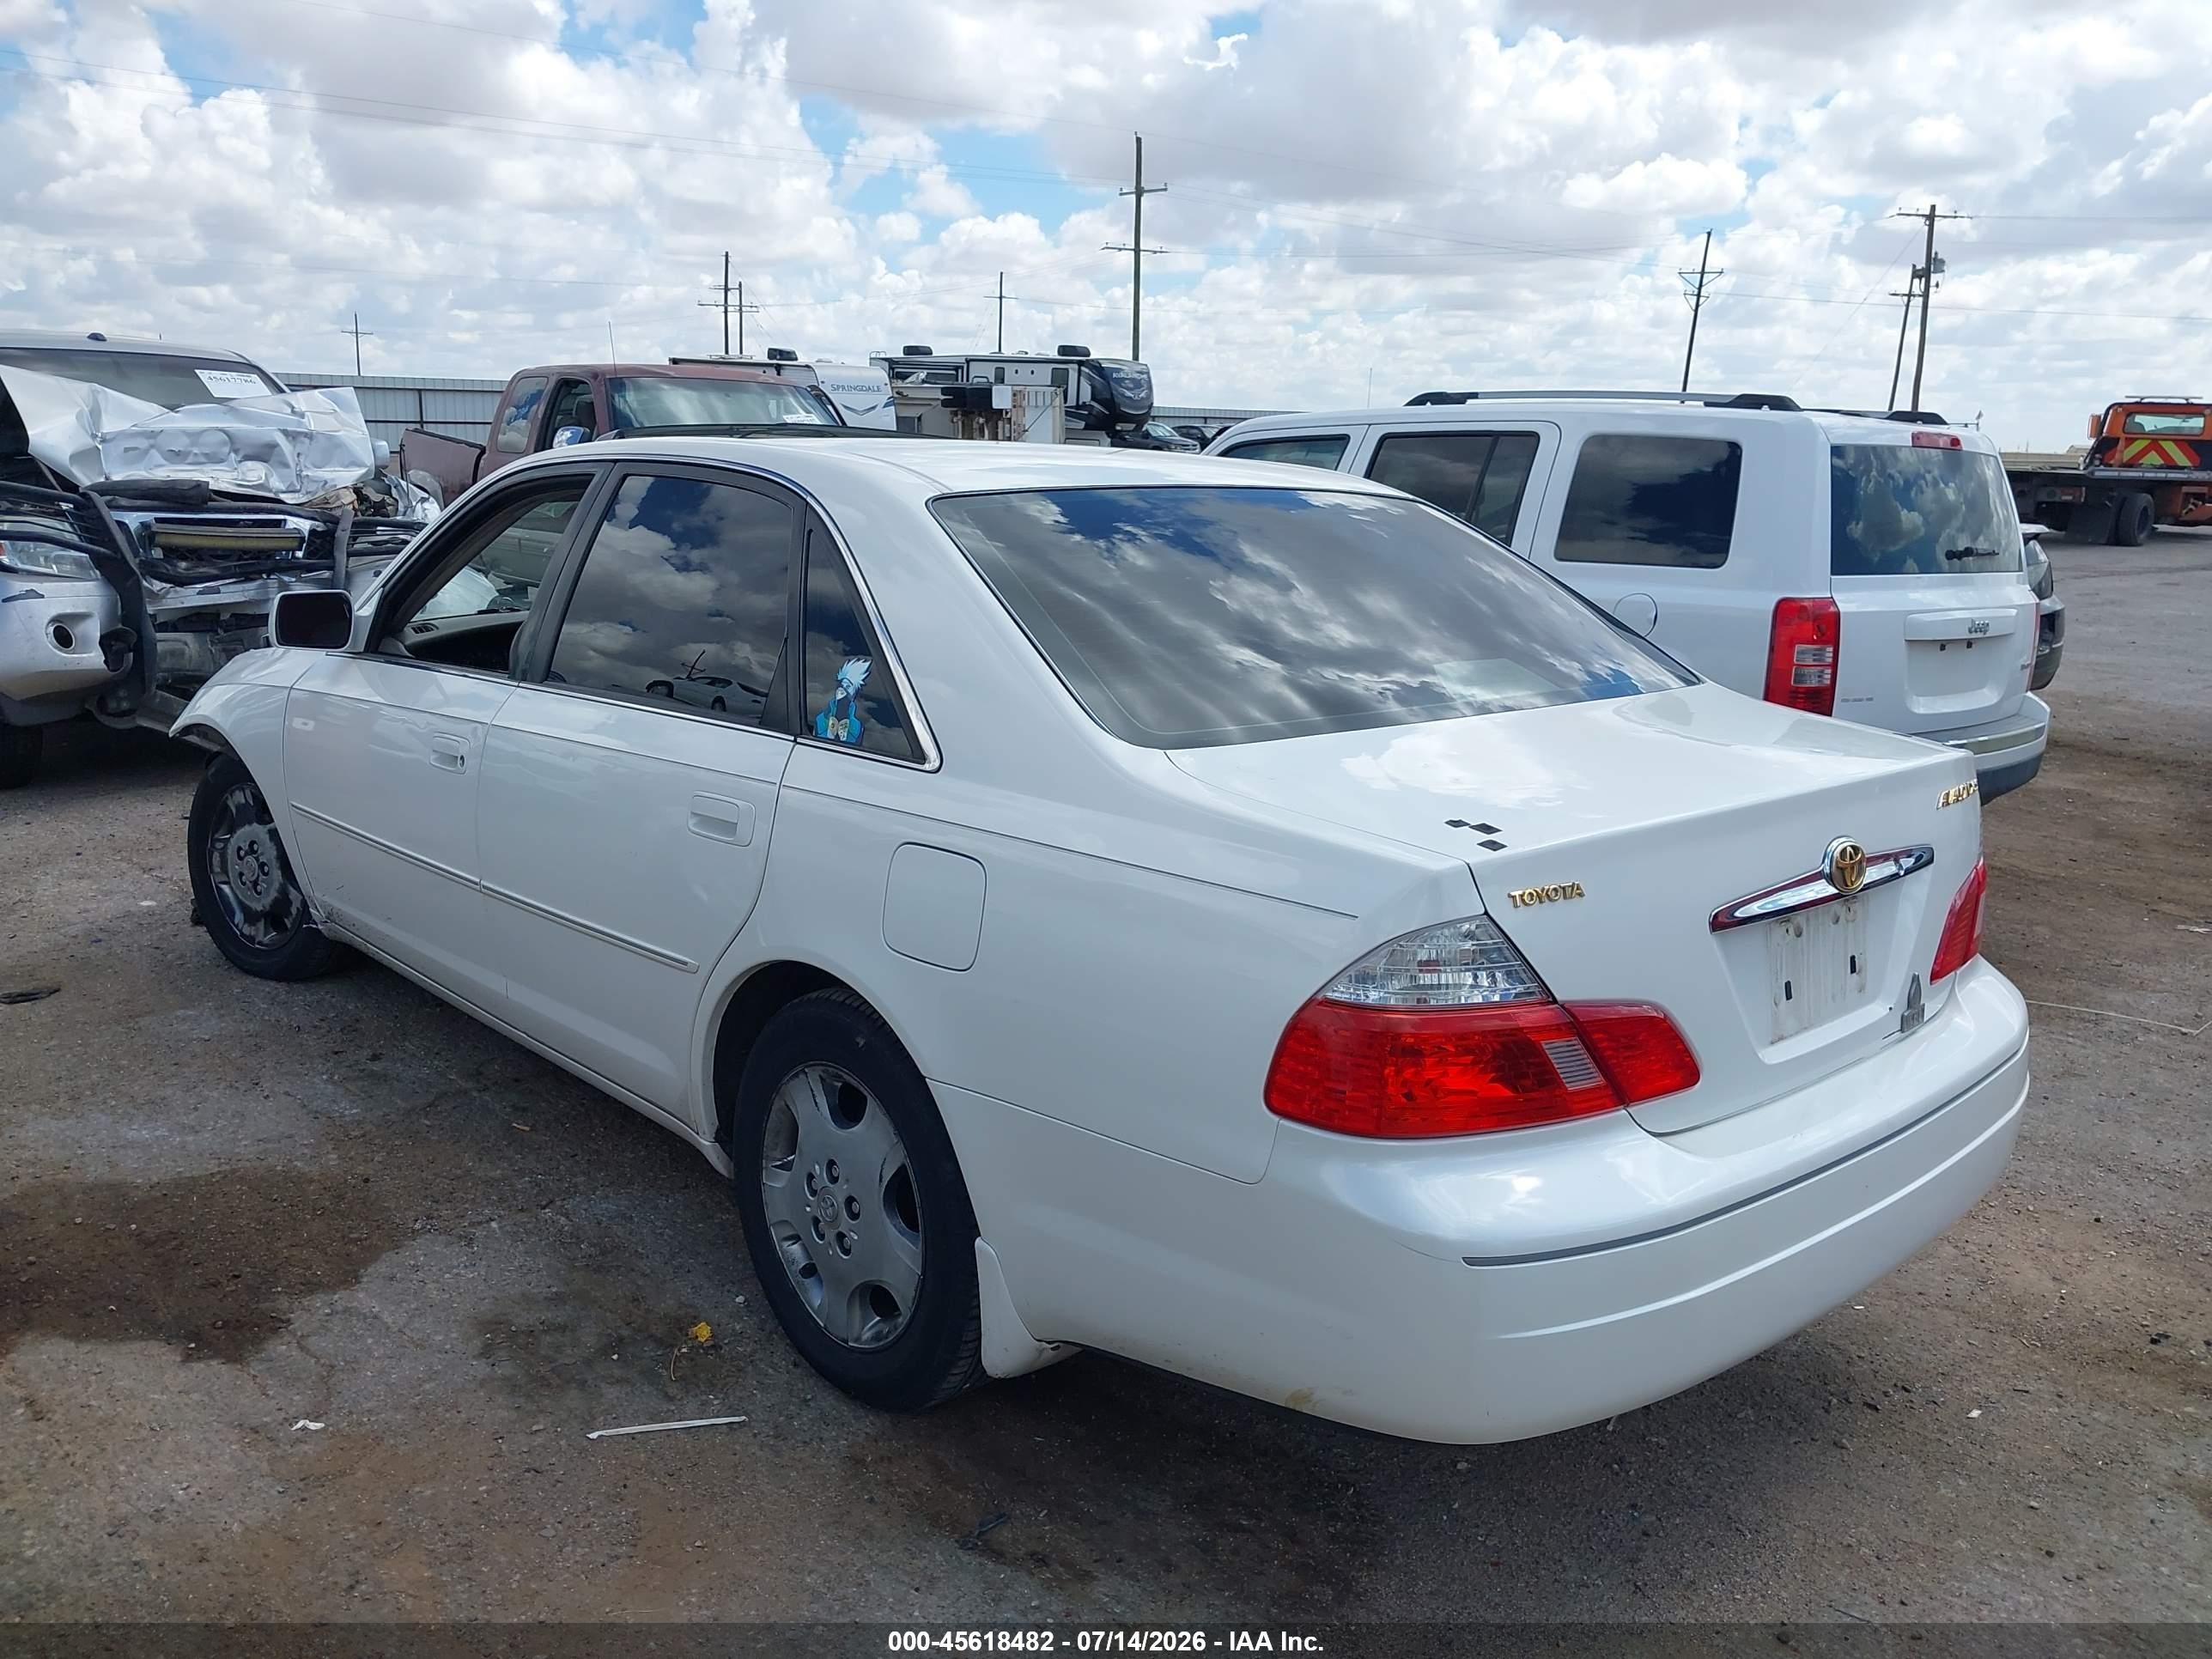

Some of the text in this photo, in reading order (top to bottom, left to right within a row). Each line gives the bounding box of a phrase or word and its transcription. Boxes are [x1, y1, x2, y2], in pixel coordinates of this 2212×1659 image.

[830, 384, 882, 392] SPRINGDALE
[1967, 618, 1990, 635] Jeep
[1508, 881, 1585, 908] TOYOTA
